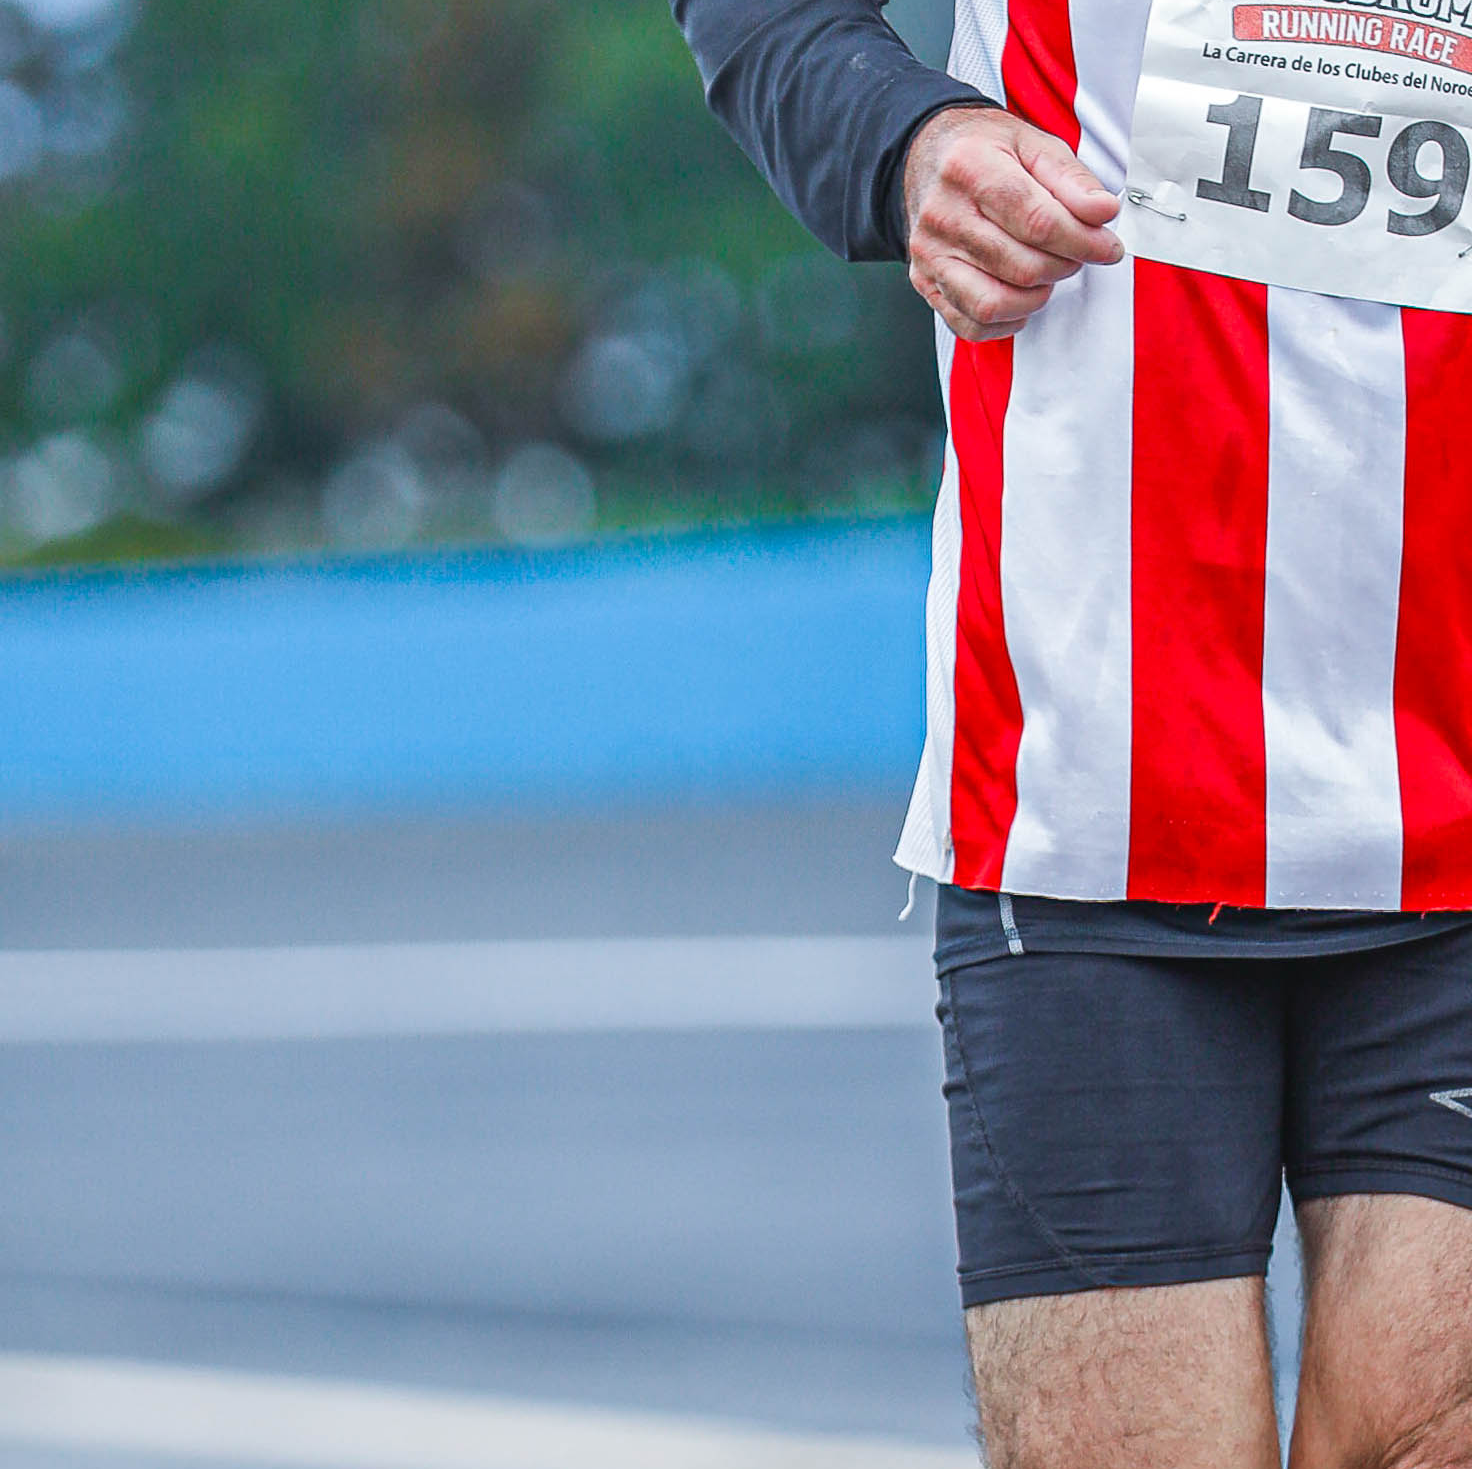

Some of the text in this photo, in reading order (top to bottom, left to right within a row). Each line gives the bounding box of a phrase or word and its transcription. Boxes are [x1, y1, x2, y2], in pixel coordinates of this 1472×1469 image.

[1262, 10, 1459, 64] RUNNING RACE
[1202, 42, 1221, 59] La
[1225, 46, 1287, 69] Carrera
[1292, 55, 1312, 72] de
[1316, 57, 1341, 76] los
[1344, 62, 1399, 86] Clubes
[1402, 71, 1427, 90] del
[1195, 94, 1470, 237] 159
